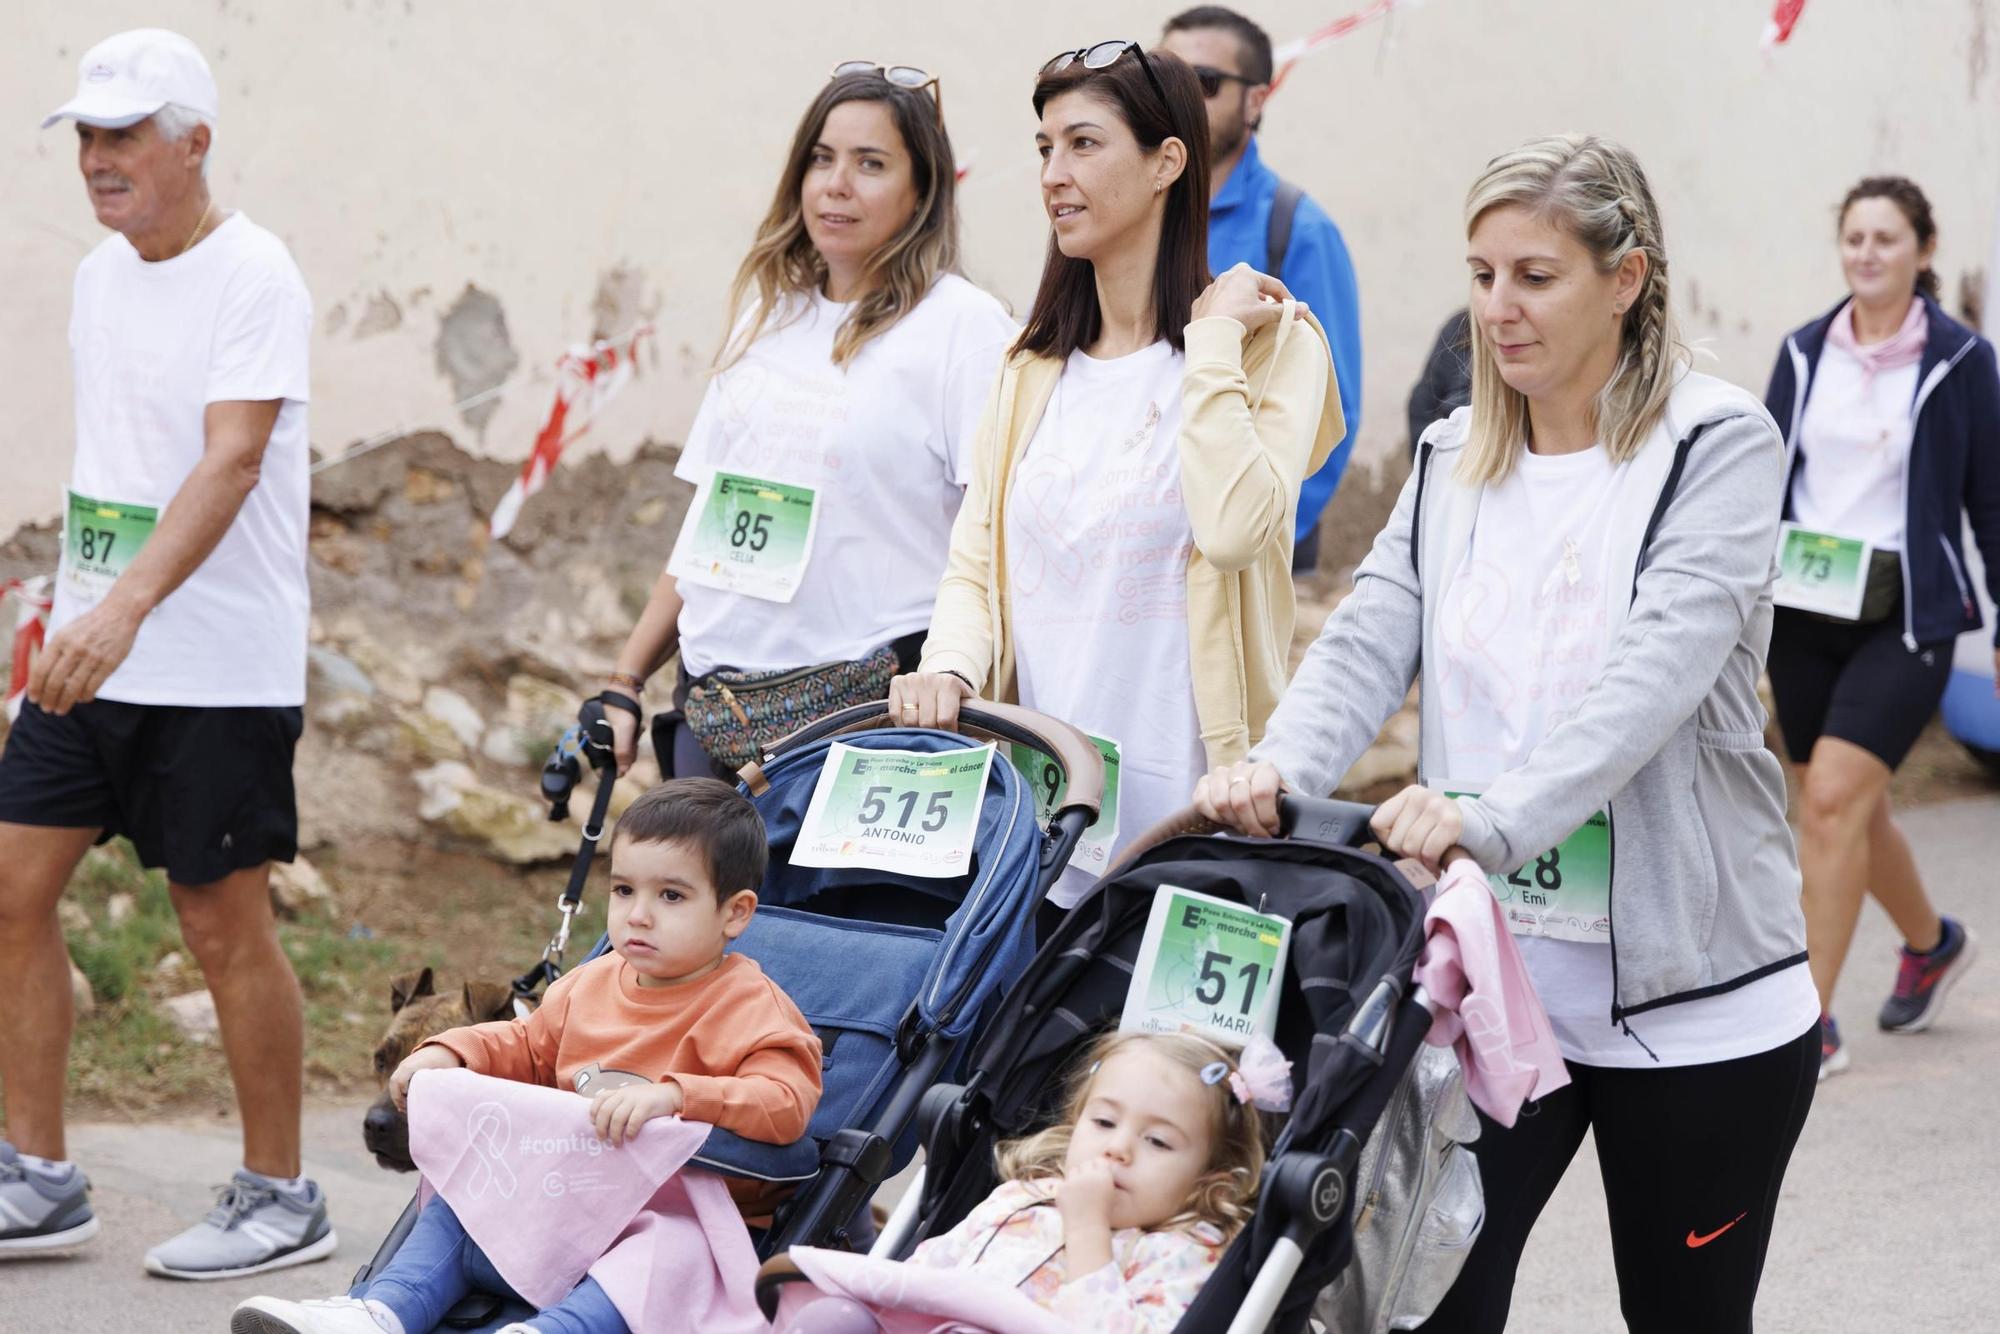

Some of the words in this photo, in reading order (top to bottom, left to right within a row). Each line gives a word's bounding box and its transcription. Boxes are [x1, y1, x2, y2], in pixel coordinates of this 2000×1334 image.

[81, 527, 116, 564] 87
[731, 510, 773, 551] 85
[1801, 551, 1832, 580] 73
[880, 764, 917, 775] marcha
[950, 765, 958, 774] el
[960, 762, 984, 773] cáncer
[858, 786, 953, 832] 515
[861, 827, 926, 846] ANTONIO
[1523, 890, 1547, 906] Emi
[1182, 905, 1207, 929] En
[1217, 923, 1257, 940] marcha
[1195, 951, 1273, 1015] 51
